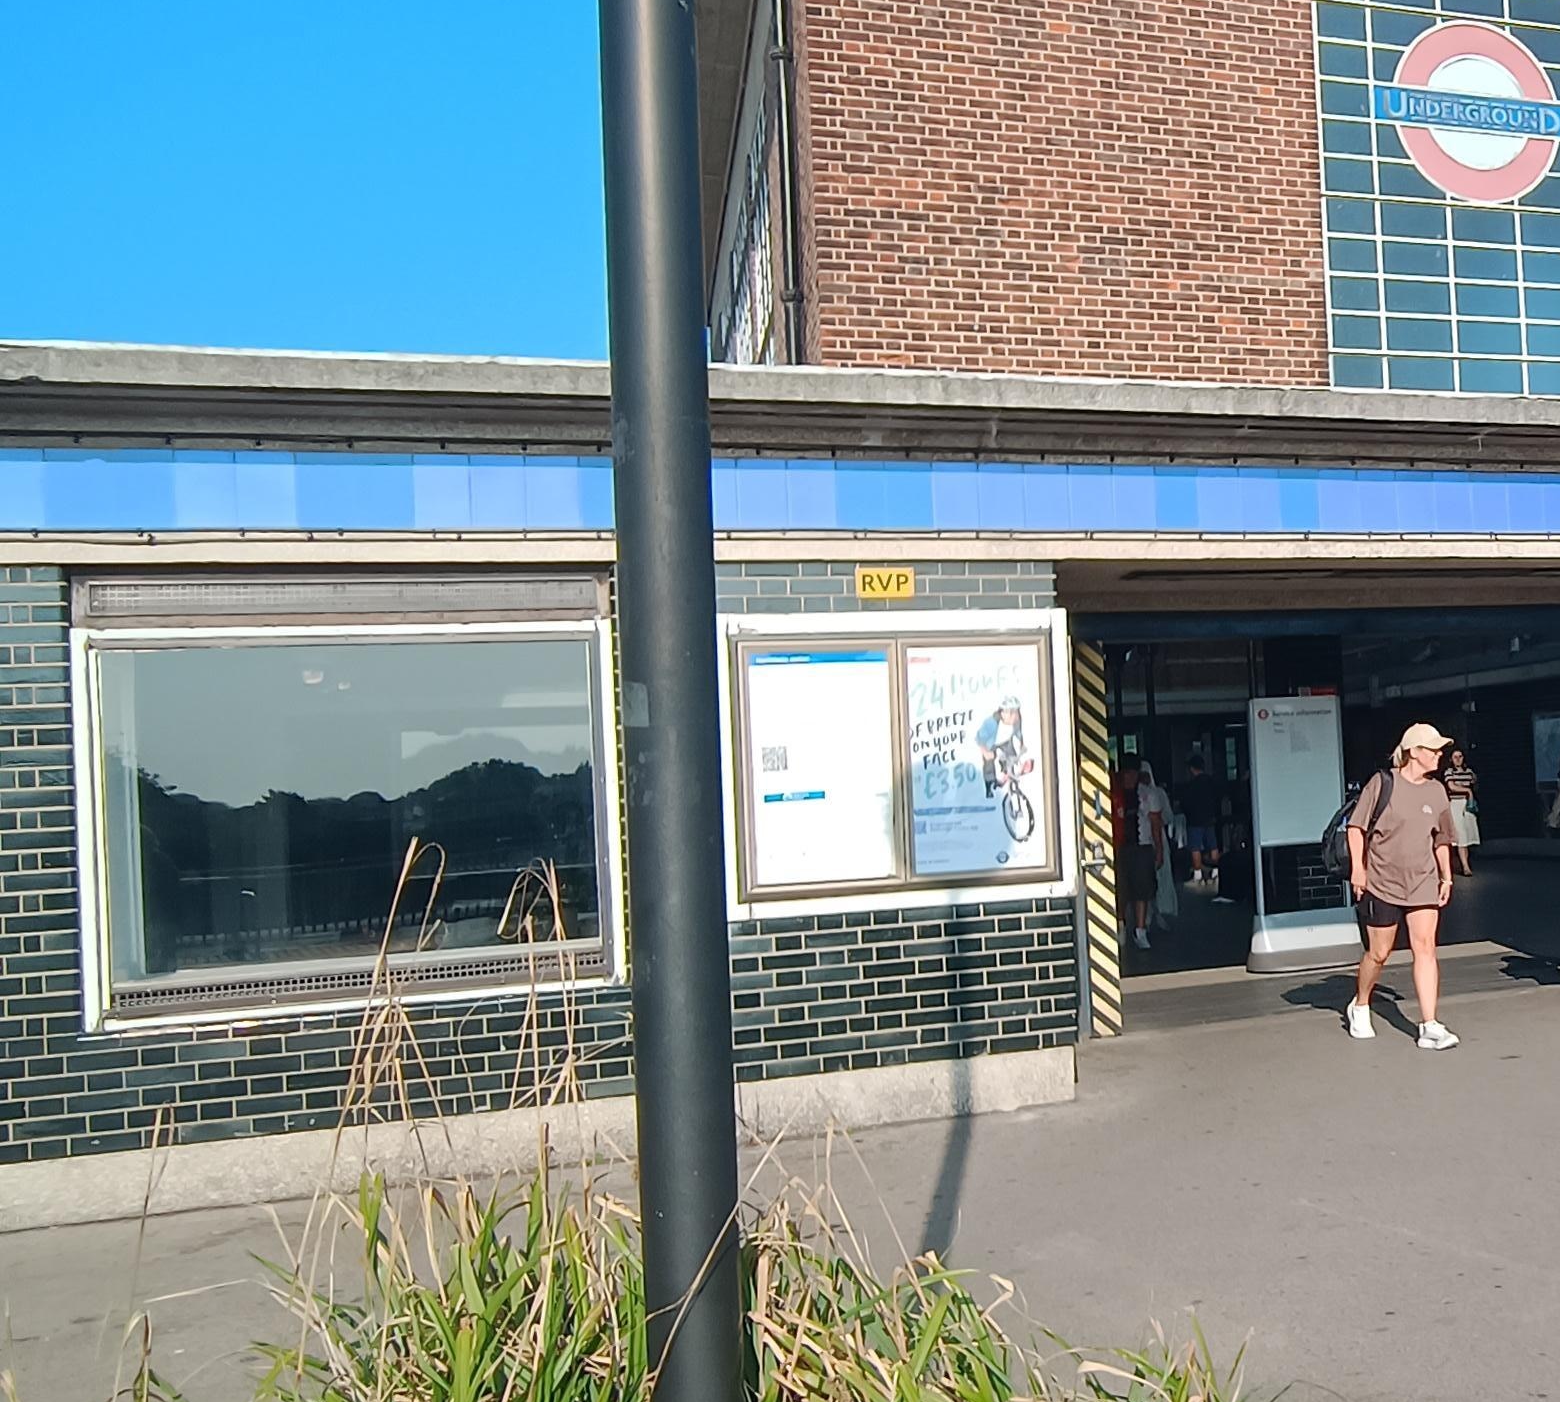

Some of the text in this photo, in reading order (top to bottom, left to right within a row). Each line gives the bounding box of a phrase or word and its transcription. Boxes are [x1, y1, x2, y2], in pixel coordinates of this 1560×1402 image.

[1383, 90, 1560, 134] UNDERGROUND
[862, 573, 909, 592] RVP
[910, 679, 944, 718] 24
[924, 762, 977, 799] £3.50
